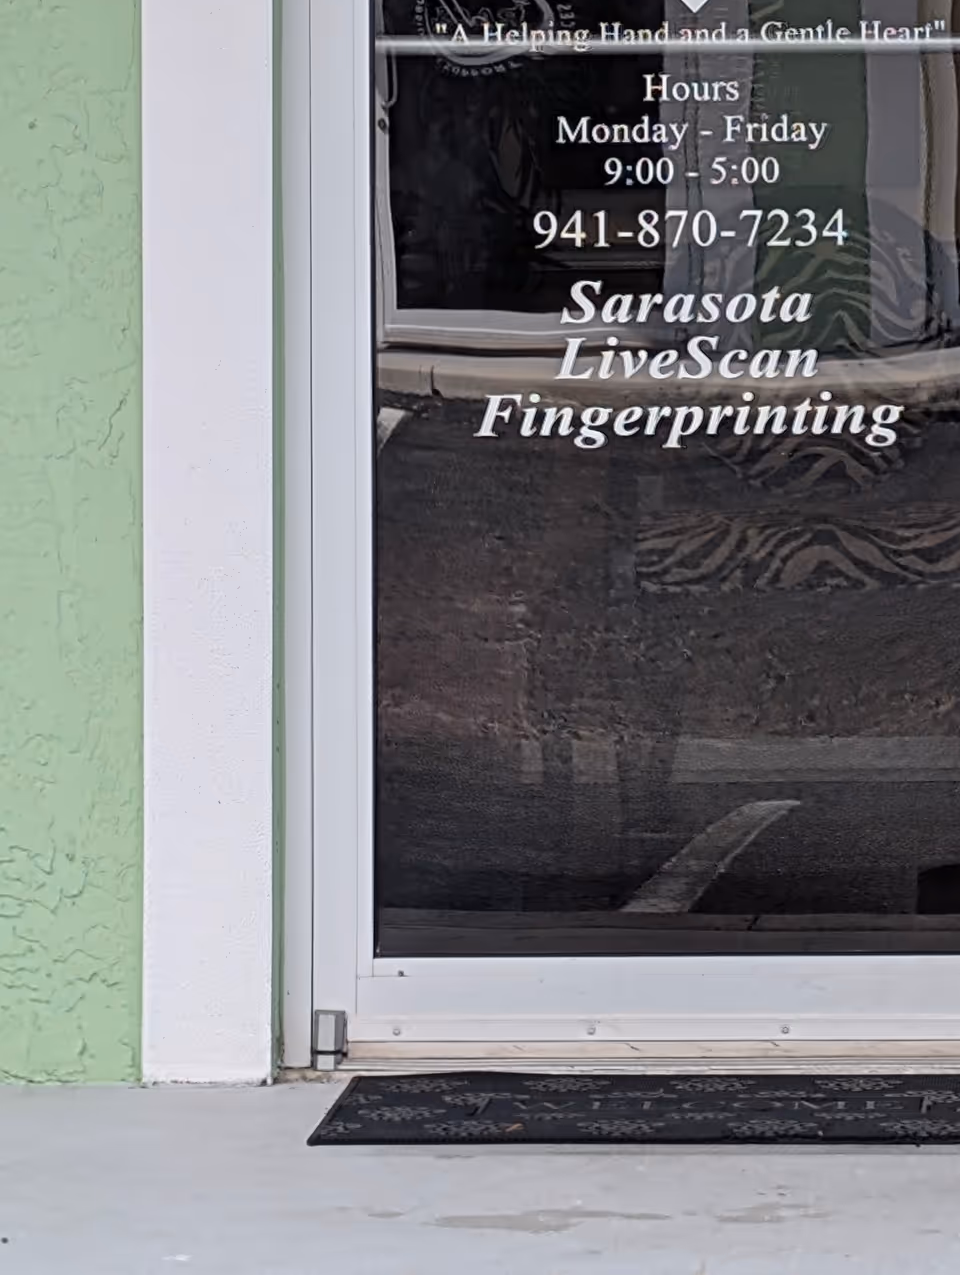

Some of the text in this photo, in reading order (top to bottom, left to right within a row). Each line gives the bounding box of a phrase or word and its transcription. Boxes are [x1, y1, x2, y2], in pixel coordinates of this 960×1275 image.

[436, 19, 946, 53] "A Helping Hand and a Gentle Heart"
[642, 73, 741, 103] Hours
[556, 115, 689, 150] Monday
[723, 114, 828, 150] Friday
[604, 156, 675, 186] 9:00
[712, 156, 780, 185] 5:00
[533, 209, 849, 249] 941-870-7234
[559, 280, 814, 324] Sarasota
[554, 336, 820, 381] LiveScan
[473, 392, 905, 450] Fingerprinting
